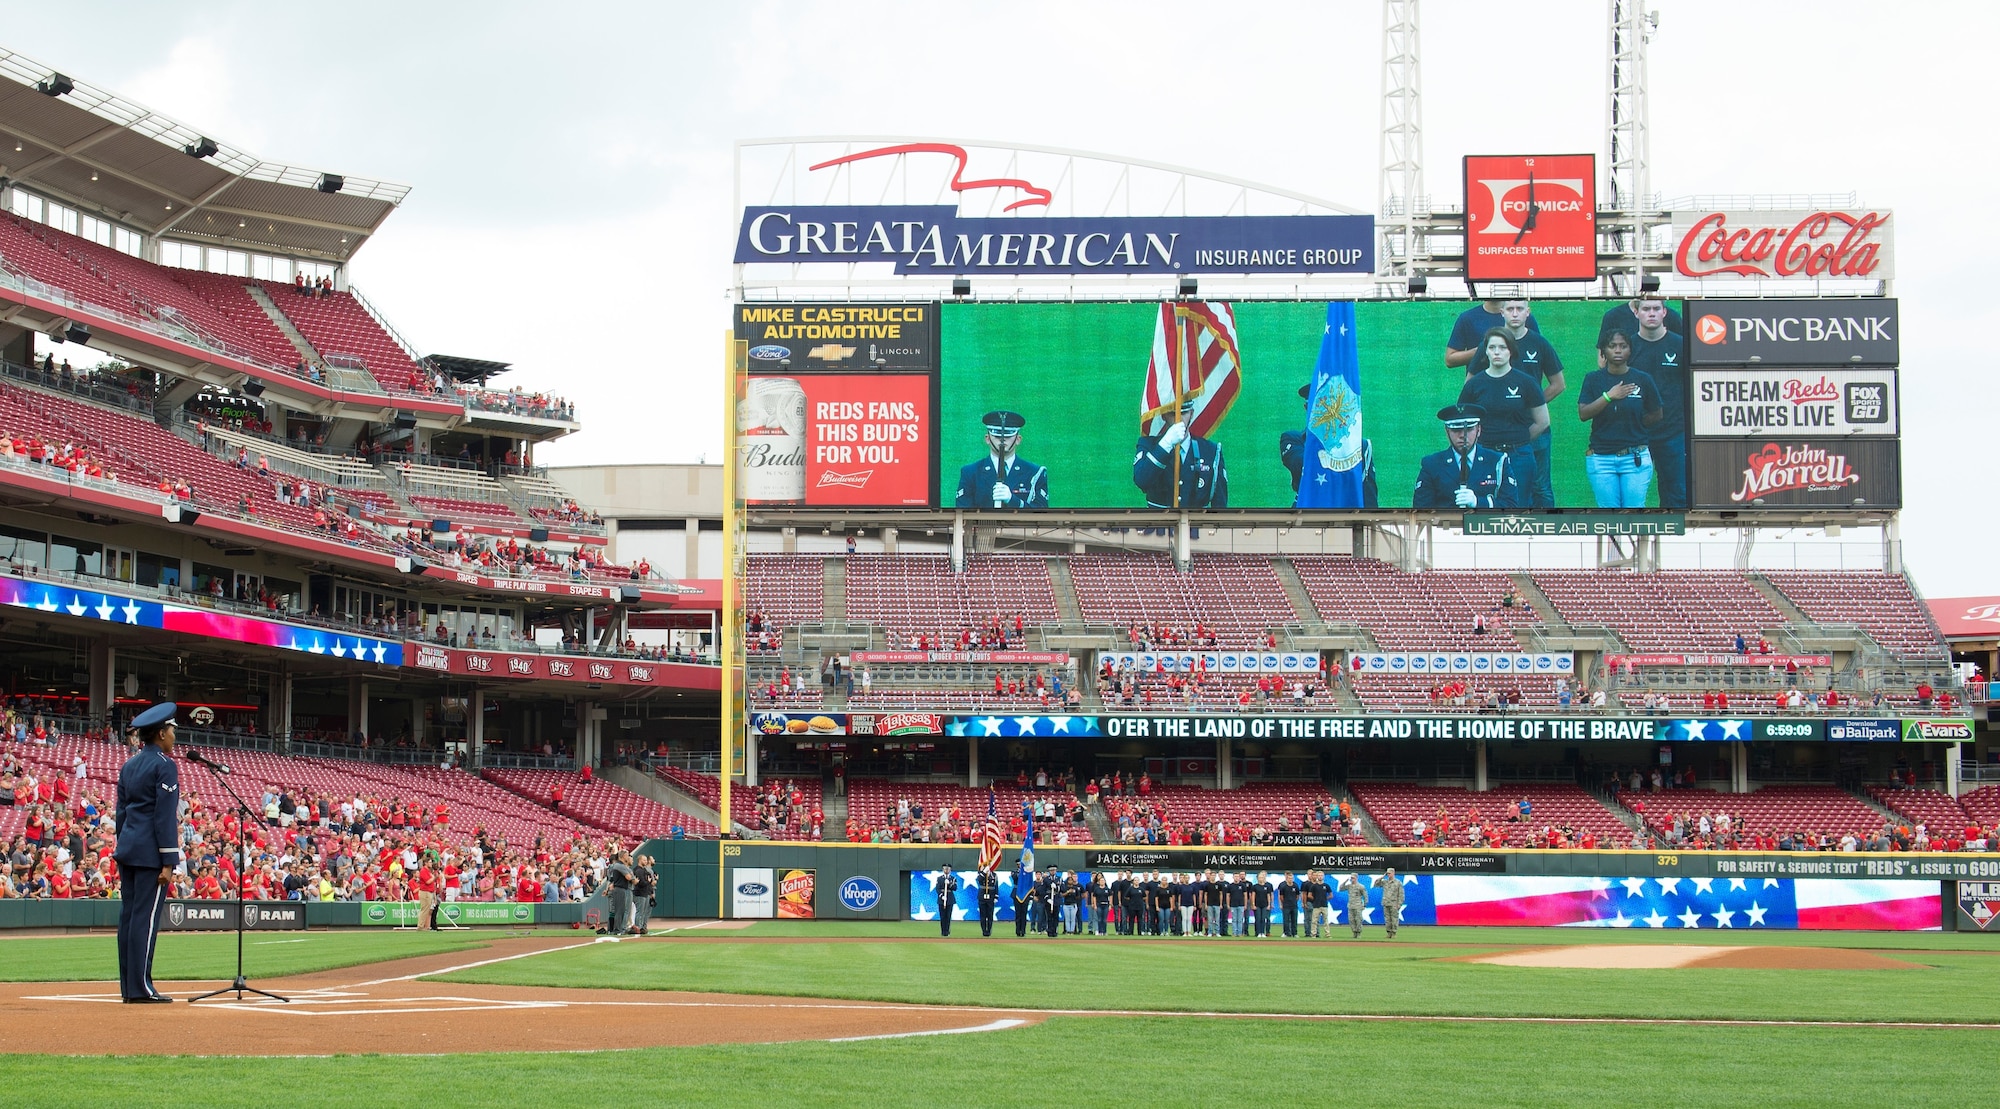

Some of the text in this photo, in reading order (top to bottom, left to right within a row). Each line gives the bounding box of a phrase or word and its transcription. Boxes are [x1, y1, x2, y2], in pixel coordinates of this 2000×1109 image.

[1525, 158, 1535, 167] 12
[748, 212, 1179, 268] GREAT AMERICAN
[1675, 211, 1892, 278] Coca-Cola
[1478, 247, 1528, 255] SURFACES
[1556, 246, 1585, 254] SHINE
[1194, 249, 1362, 267] INSURANCE GROUP
[1528, 268, 1535, 276] 6
[742, 307, 923, 322] MIKE CASTRUCCI
[763, 325, 901, 339] AUTOMOTIVE
[1731, 317, 1892, 342] PNC BANK
[755, 346, 783, 359] Ford
[1701, 376, 1840, 406] STREAM Reds
[1850, 387, 1881, 400] FOX
[816, 402, 864, 420] REDS
[869, 402, 919, 422] FANS,
[1720, 405, 1836, 427] GAMES LIVE
[1851, 406, 1881, 419] GO
[816, 424, 919, 442] THIS BUD'S
[816, 445, 900, 464] FOR YOU.
[1778, 444, 1826, 467] John
[821, 471, 868, 484] Budweiser
[1731, 455, 1860, 502] Morrell
[1469, 522, 1676, 534] ULTIMATE AIR SHUTTLE
[456, 573, 478, 585] STAPLES
[493, 580, 547, 592] TRIPLE PLAY SUITES
[569, 585, 602, 597] STAPLES
[417, 651, 448, 669] CHAMPIONS
[469, 656, 488, 670] 1919
[509, 658, 528, 673] 1940
[550, 661, 569, 675] 1975
[590, 663, 609, 677] 1976
[630, 666, 648, 679] 1990
[295, 716, 319, 728] SHOP
[1108, 719, 1654, 738] O'ER THE LAND OF THE FREE AND THE HOME OF THE BRAVE
[1767, 724, 1812, 737] 6:59:09
[1846, 727, 1896, 740] Ballpark
[1922, 723, 1969, 737] Evans
[724, 846, 741, 856] 328
[1657, 855, 1678, 866] 379
[1717, 861, 1737, 872] FOR
[1739, 861, 1777, 872] SAFETY
[1778, 863, 1786, 872] &
[1788, 862, 1832, 873] SERVICE
[1833, 863, 1859, 873] TEXT
[1911, 865, 1919, 874] &
[1921, 863, 1952, 874] ISSUE
[1953, 863, 1967, 874] TO
[1970, 861, 2000, 876] 690
[743, 884, 763, 895] Ford
[780, 876, 814, 895] Kahn's
[1961, 883, 2000, 896] MLB
[844, 882, 877, 907] Kroger
[187, 908, 225, 921] RAM
[261, 909, 295, 921] RAM
[466, 909, 474, 918] THIS
[475, 909, 480, 918] IS
[484, 909, 498, 918] SCOTTS
